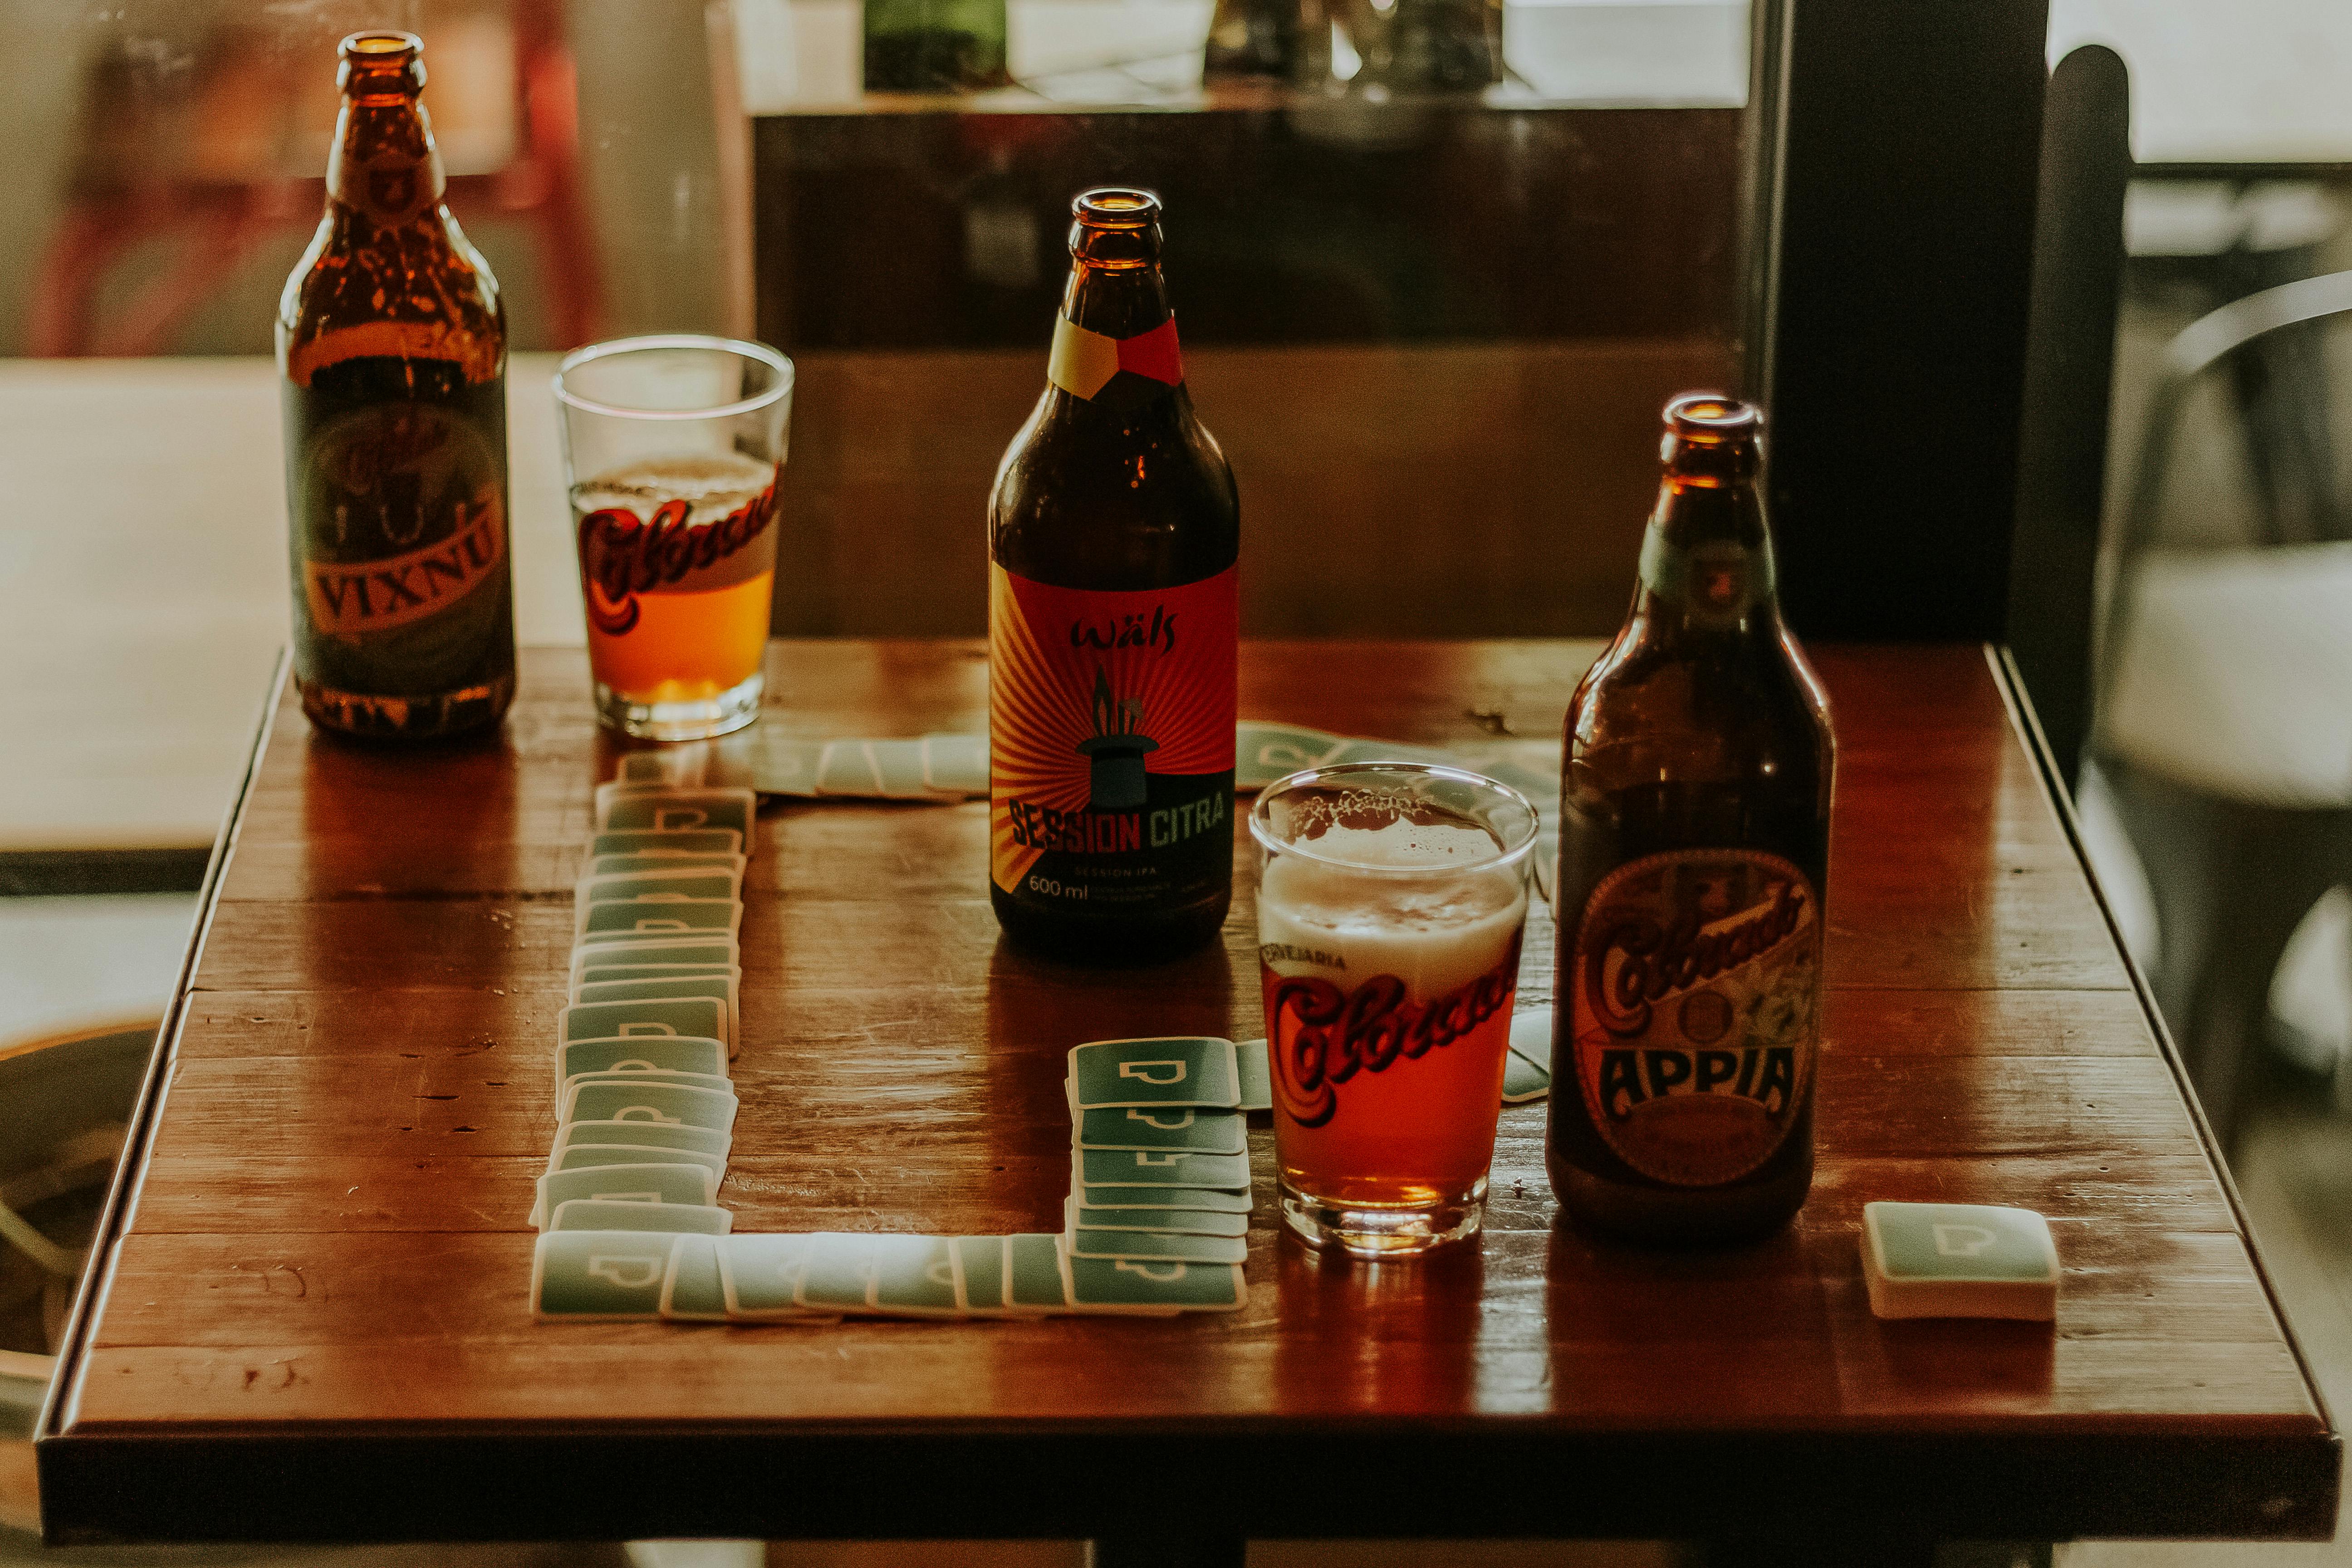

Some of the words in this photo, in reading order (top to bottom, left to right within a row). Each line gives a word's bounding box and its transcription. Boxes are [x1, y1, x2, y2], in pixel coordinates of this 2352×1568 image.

[317, 520, 495, 618] VIXNU
[1009, 798, 1141, 853] SESSION
[1150, 791, 1224, 848] CITRA
[1029, 875, 1061, 897] 600
[1064, 884, 1089, 901] ml
[1074, 867, 1132, 878] SESSION
[1136, 866, 1157, 876] IPA
[1599, 1048, 1793, 1122] APPIA
